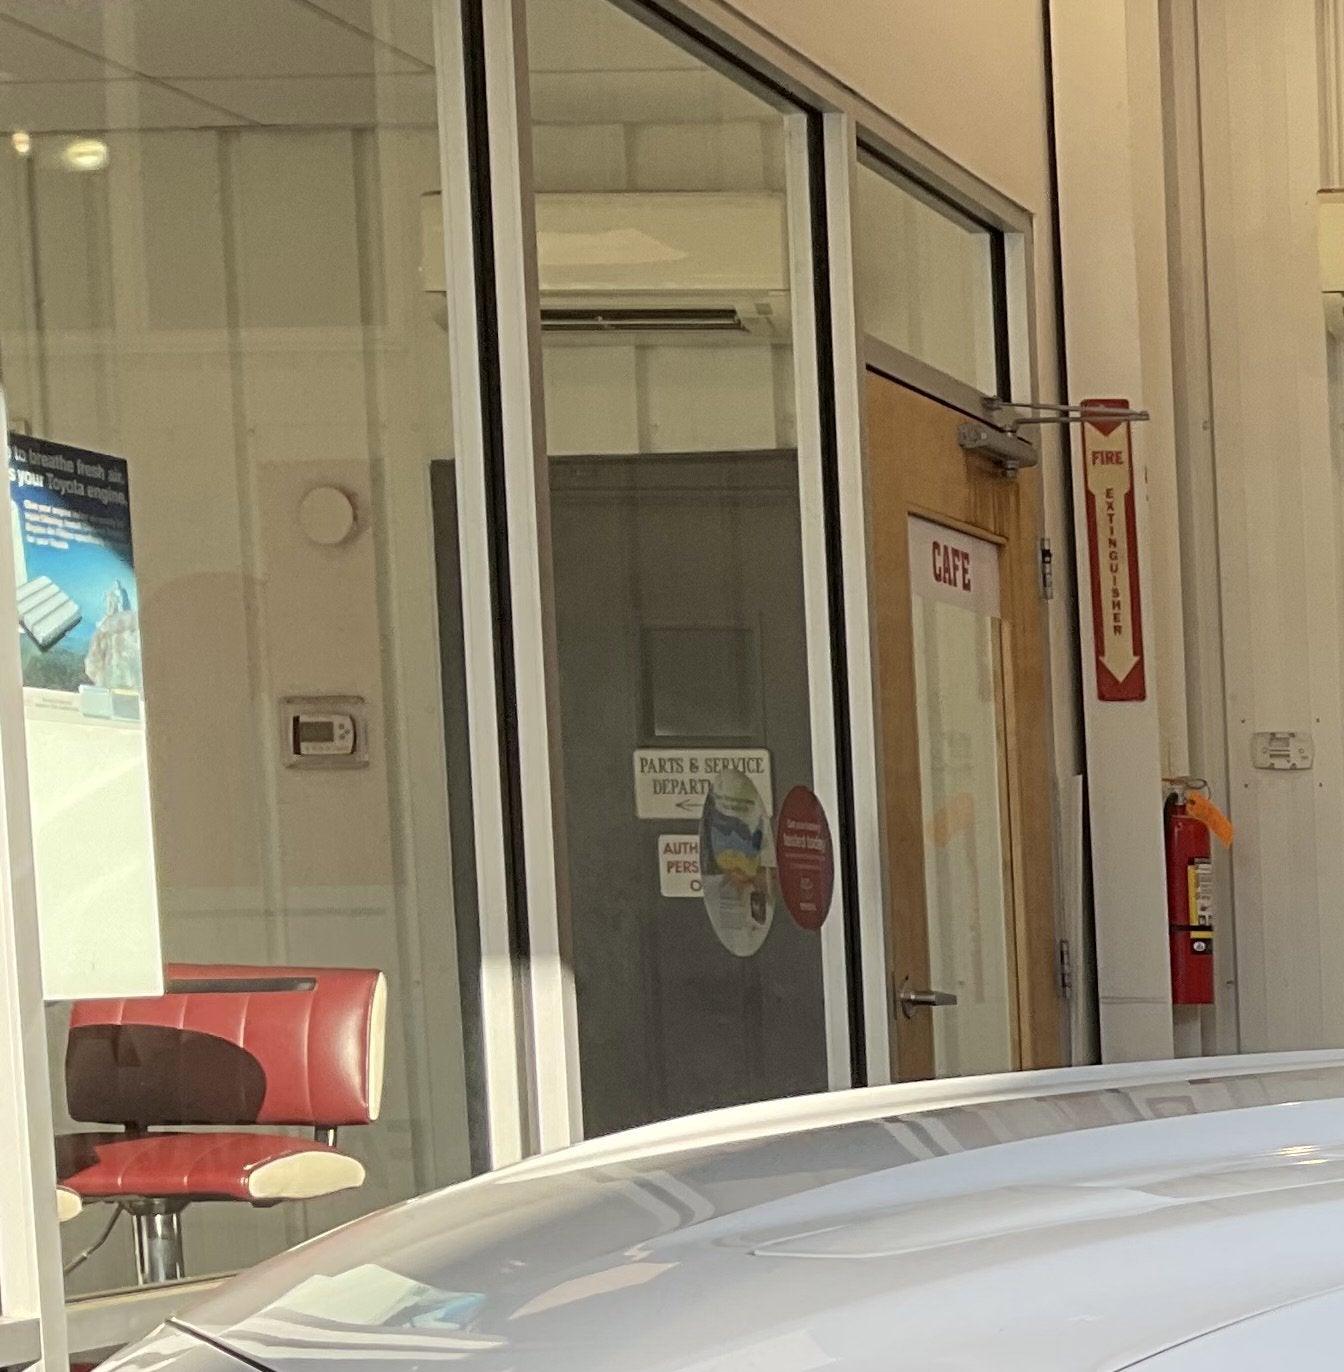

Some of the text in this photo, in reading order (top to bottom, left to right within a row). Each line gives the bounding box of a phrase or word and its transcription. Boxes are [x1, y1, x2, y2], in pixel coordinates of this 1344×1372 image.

[28, 448, 75, 473] breathe
[76, 459, 105, 480] fresh
[1091, 451, 1124, 466] FIRE
[17, 469, 44, 487] your
[46, 473, 85, 495] Toyota
[932, 540, 971, 592] CAFE
[1105, 488, 1122, 636] EXTINGUISHER
[640, 757, 764, 774] PARTS & SERVICE
[652, 779, 711, 796] DEPART
[663, 842, 699, 855] AUTH
[666, 860, 699, 874] PERS
